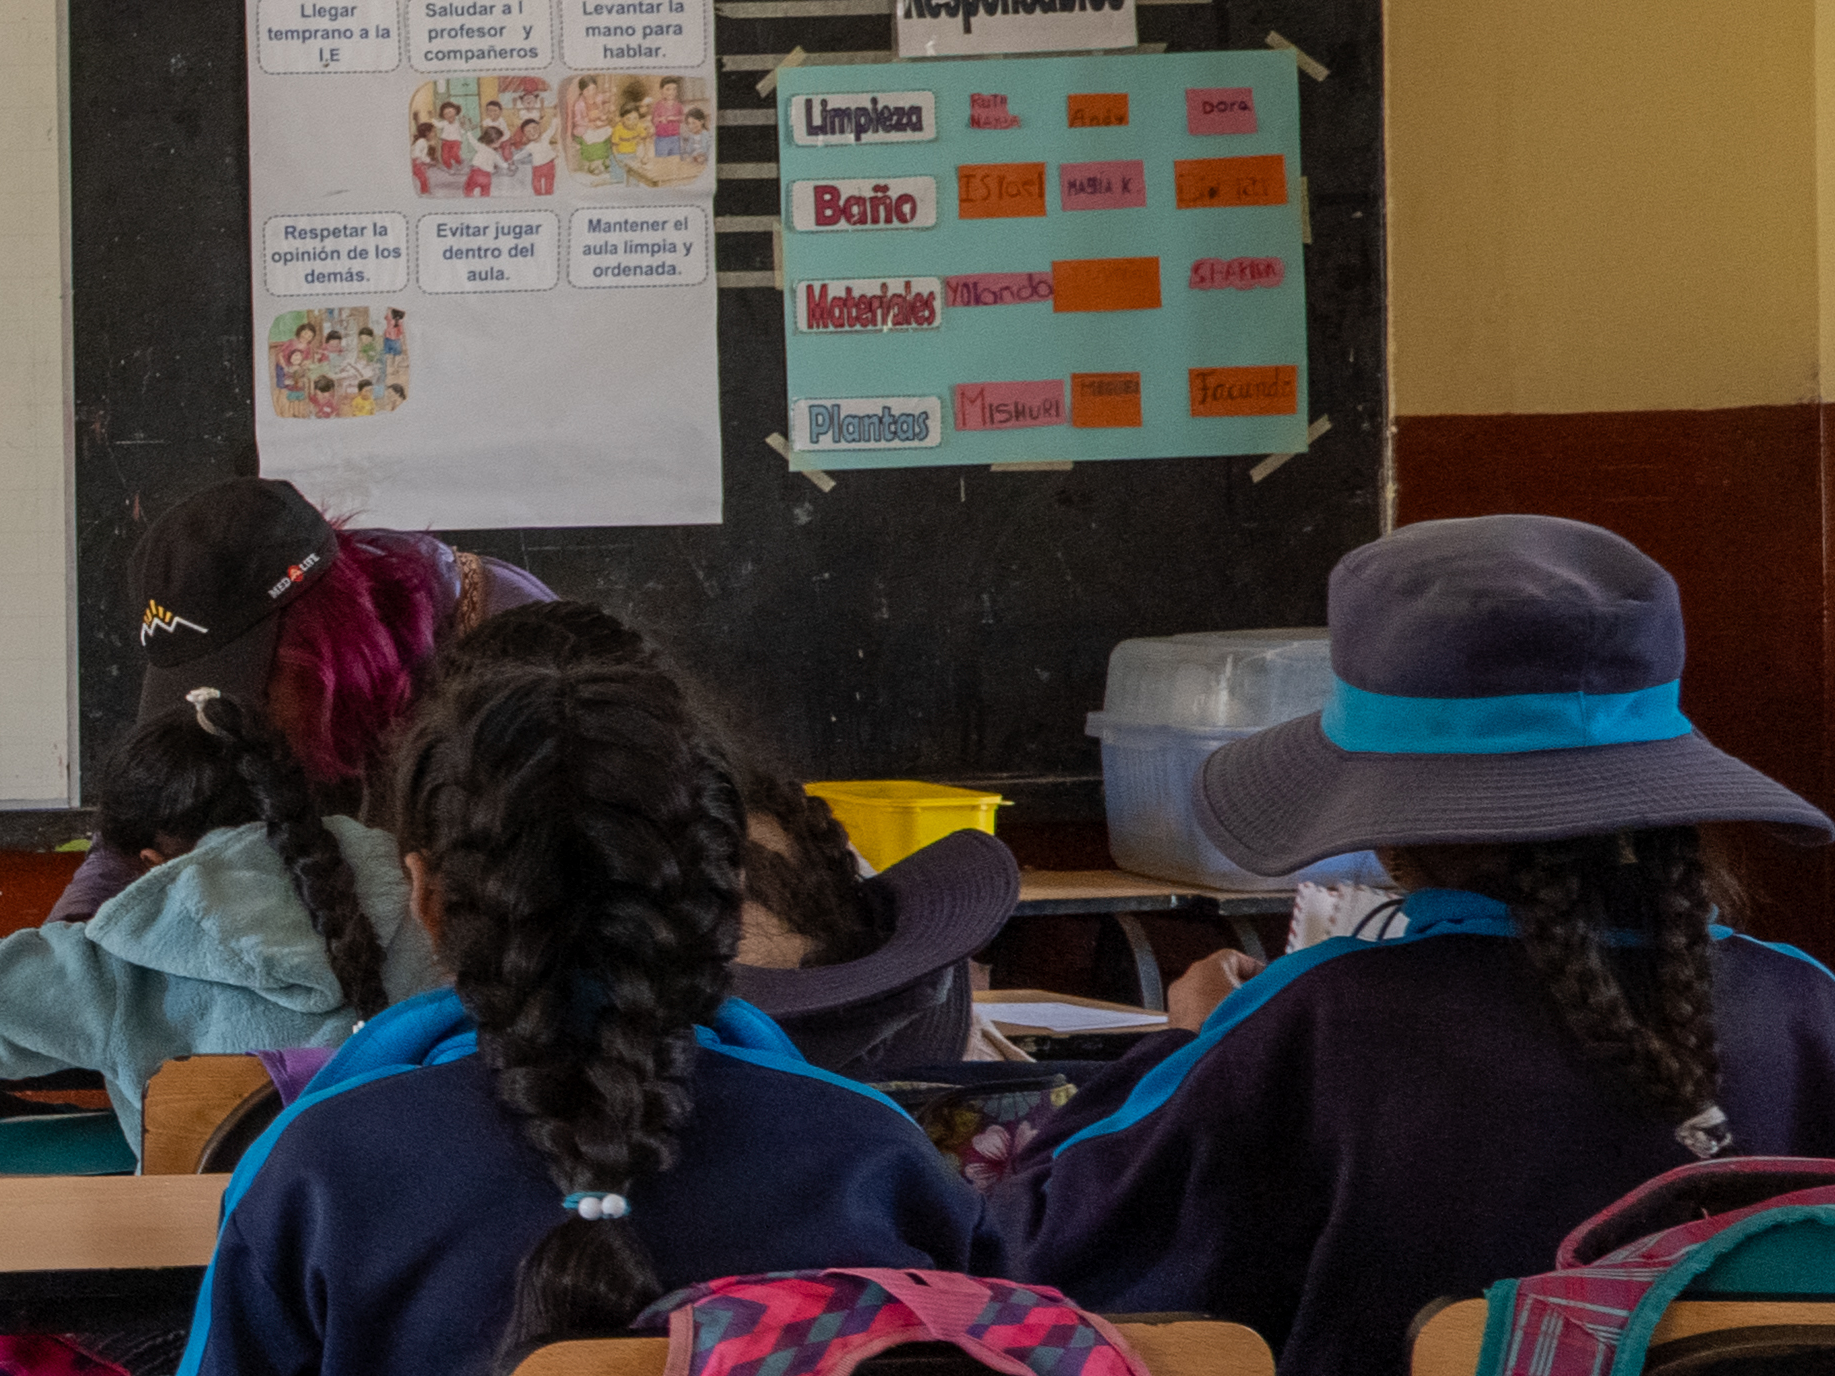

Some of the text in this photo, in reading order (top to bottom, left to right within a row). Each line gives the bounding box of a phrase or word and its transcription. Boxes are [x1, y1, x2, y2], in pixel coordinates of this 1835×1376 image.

[299, 3, 358, 23] Llegar
[425, 0, 512, 18] Saludar a
[267, 25, 391, 45] temprano a la
[427, 22, 533, 44] profesor y
[584, 23, 684, 43] mano para
[424, 42, 539, 66] compañeros
[602, 43, 667, 62] hablar.
[805, 96, 924, 142] Limpieza
[813, 184, 918, 227] Baño
[283, 222, 389, 245] Respetar la
[436, 221, 542, 243] Evitar jugar
[587, 216, 689, 236] Mantener el
[271, 243, 402, 266] opinión de los
[442, 241, 535, 261] dentro del
[582, 239, 694, 261] aula limpia y
[304, 266, 371, 285] demás.
[466, 266, 511, 283] aula.
[592, 261, 683, 280] ordenada.
[806, 280, 937, 330] Materiales
[808, 404, 929, 445] Plantas
